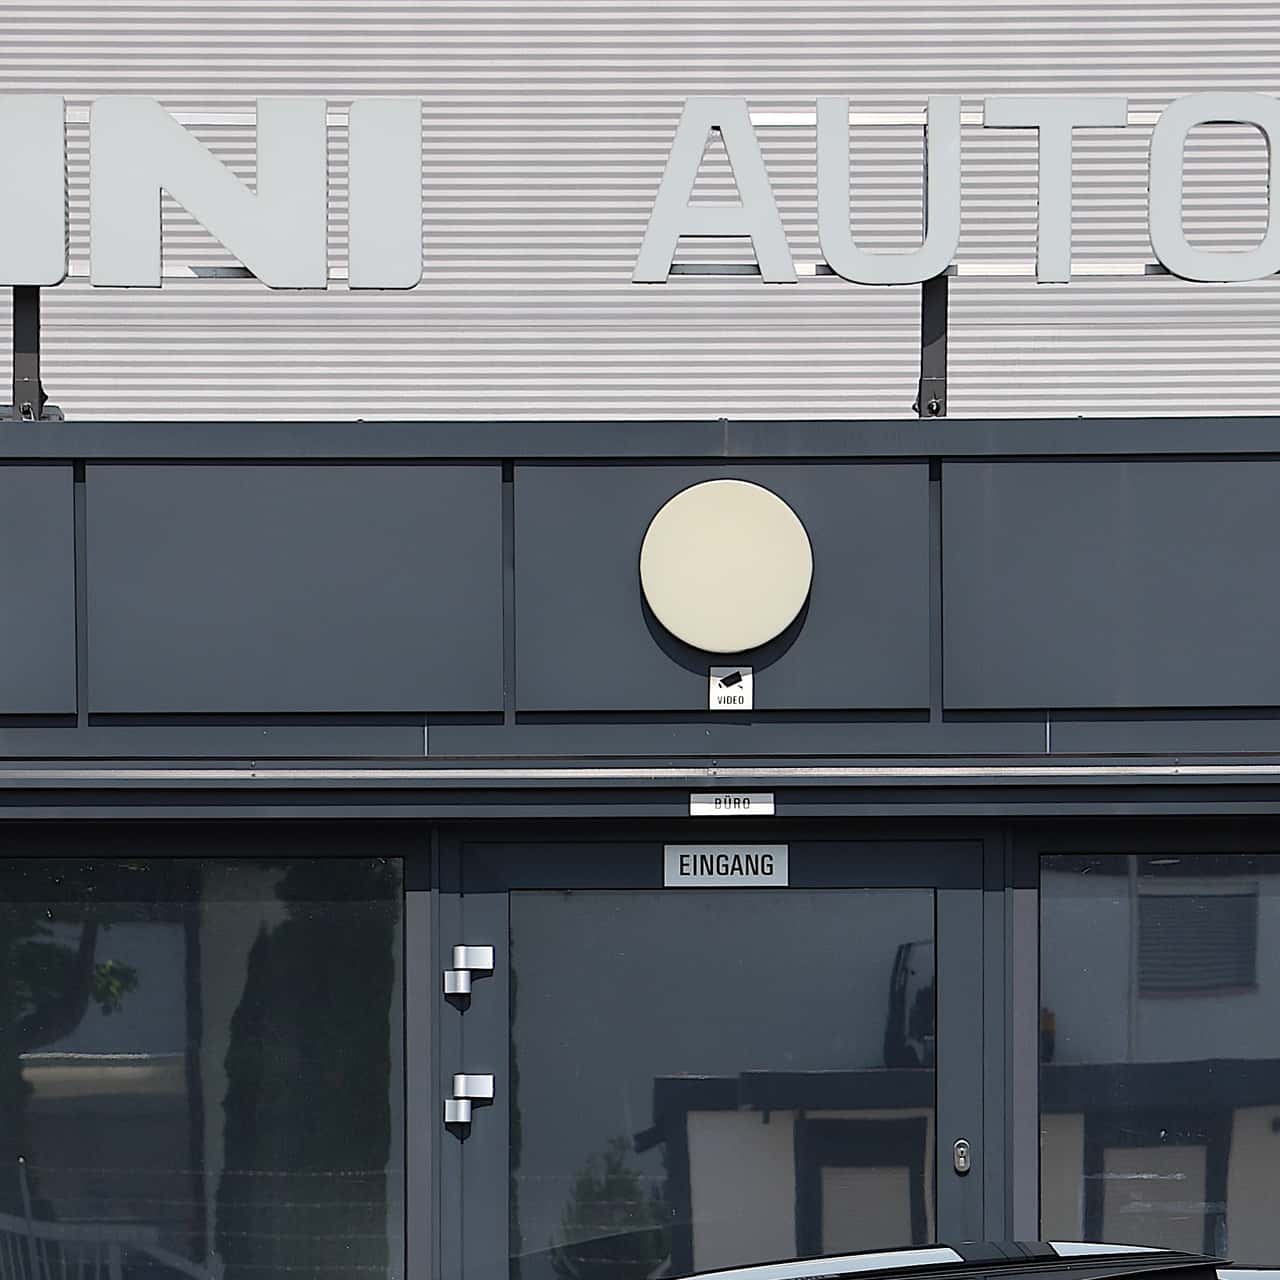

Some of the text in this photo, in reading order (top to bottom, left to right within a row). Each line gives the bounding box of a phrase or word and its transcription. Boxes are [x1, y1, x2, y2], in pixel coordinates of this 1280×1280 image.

[717, 695, 745, 705] VIDEO
[714, 795, 751, 810] BÜRO
[678, 853, 774, 877] EINGANG
